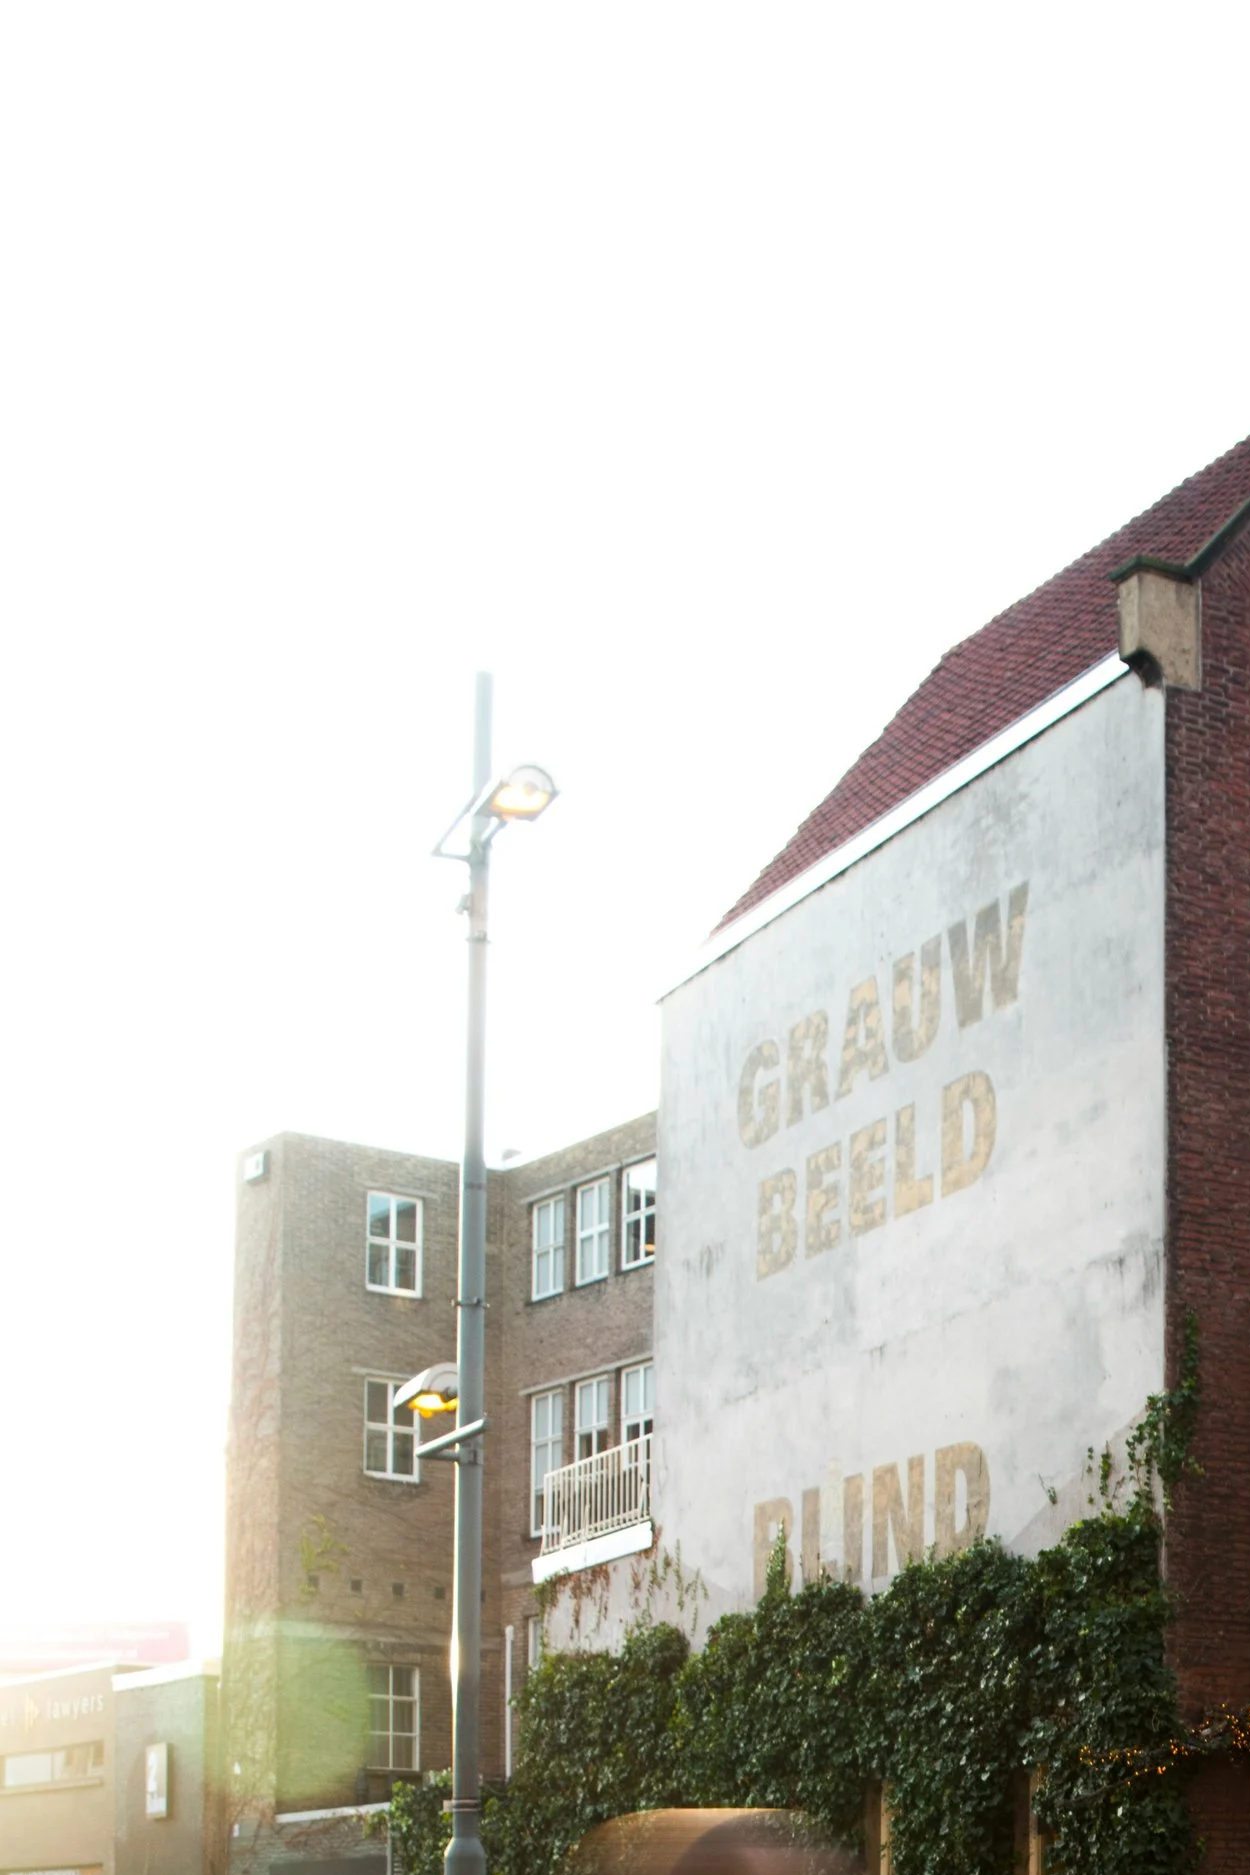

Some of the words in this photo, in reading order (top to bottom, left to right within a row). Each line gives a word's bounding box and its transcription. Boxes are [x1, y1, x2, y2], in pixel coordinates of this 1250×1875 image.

[736, 880, 1029, 1149] GRAUW
[756, 1070, 997, 1281] BEELD
[753, 1440, 991, 1600] BLIND
[47, 1694, 104, 1721] lawyers
